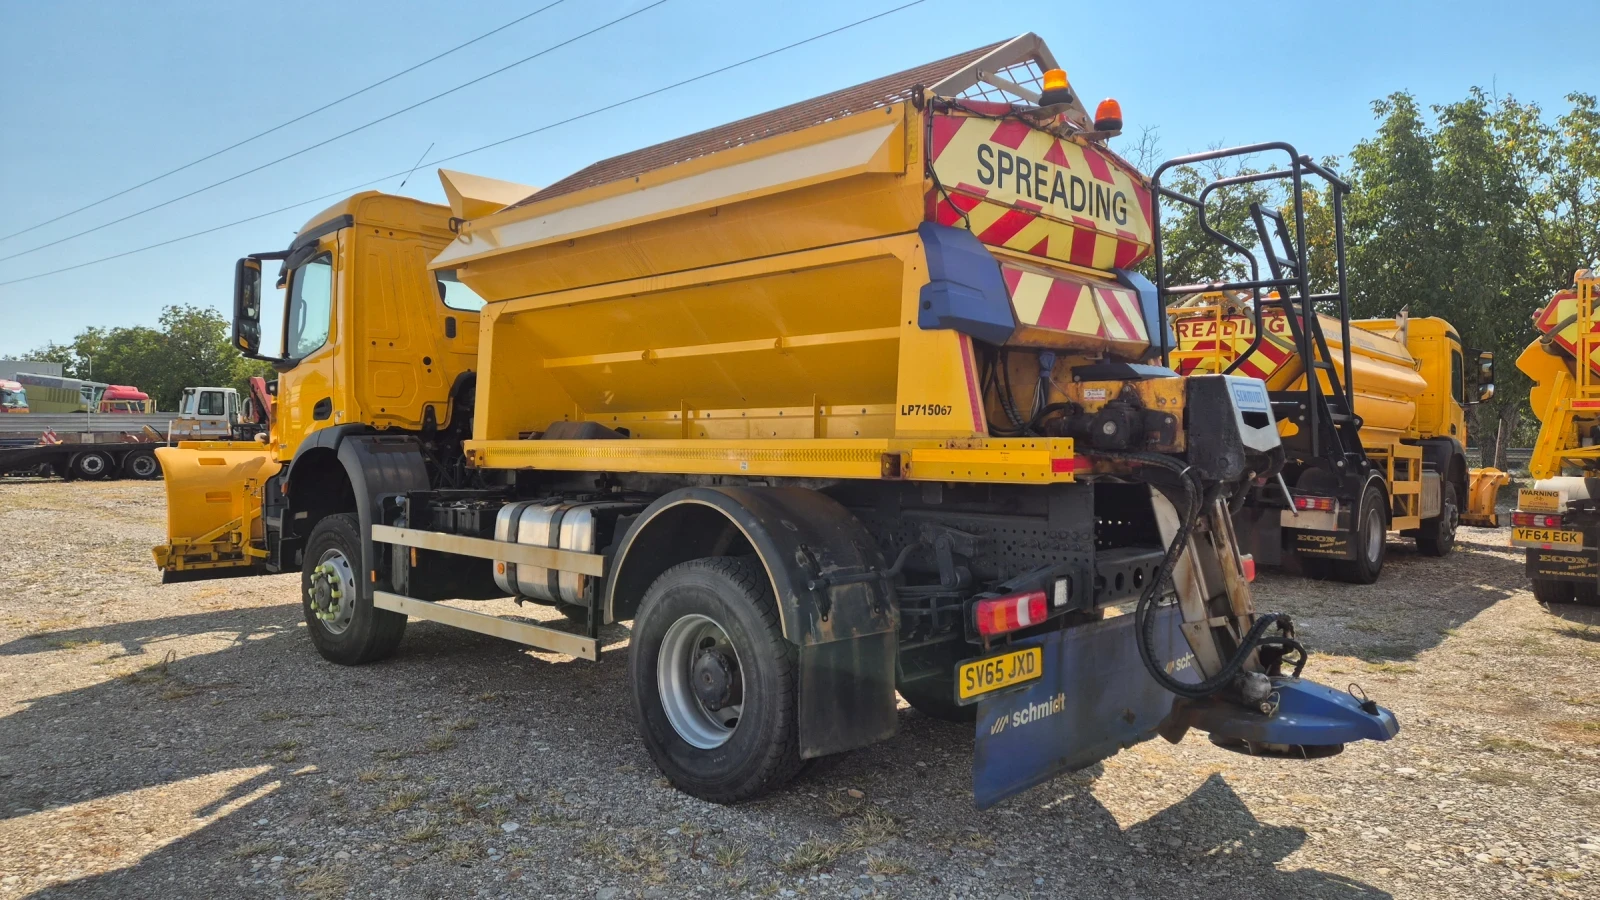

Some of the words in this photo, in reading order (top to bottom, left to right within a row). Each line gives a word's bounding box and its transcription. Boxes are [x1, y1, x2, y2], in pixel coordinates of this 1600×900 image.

[977, 143, 1127, 226] SPREADING
[901, 404, 952, 416] LP715067
[1520, 489, 1559, 497] WARNING
[1297, 534, 1336, 542] ECON
[1518, 529, 1549, 541] YF64
[1553, 531, 1577, 542] EGK
[1539, 554, 1589, 563] ECON
[965, 659, 1004, 692] SV65
[1008, 651, 1035, 680] JXD
[1012, 692, 1066, 728] schmidt
